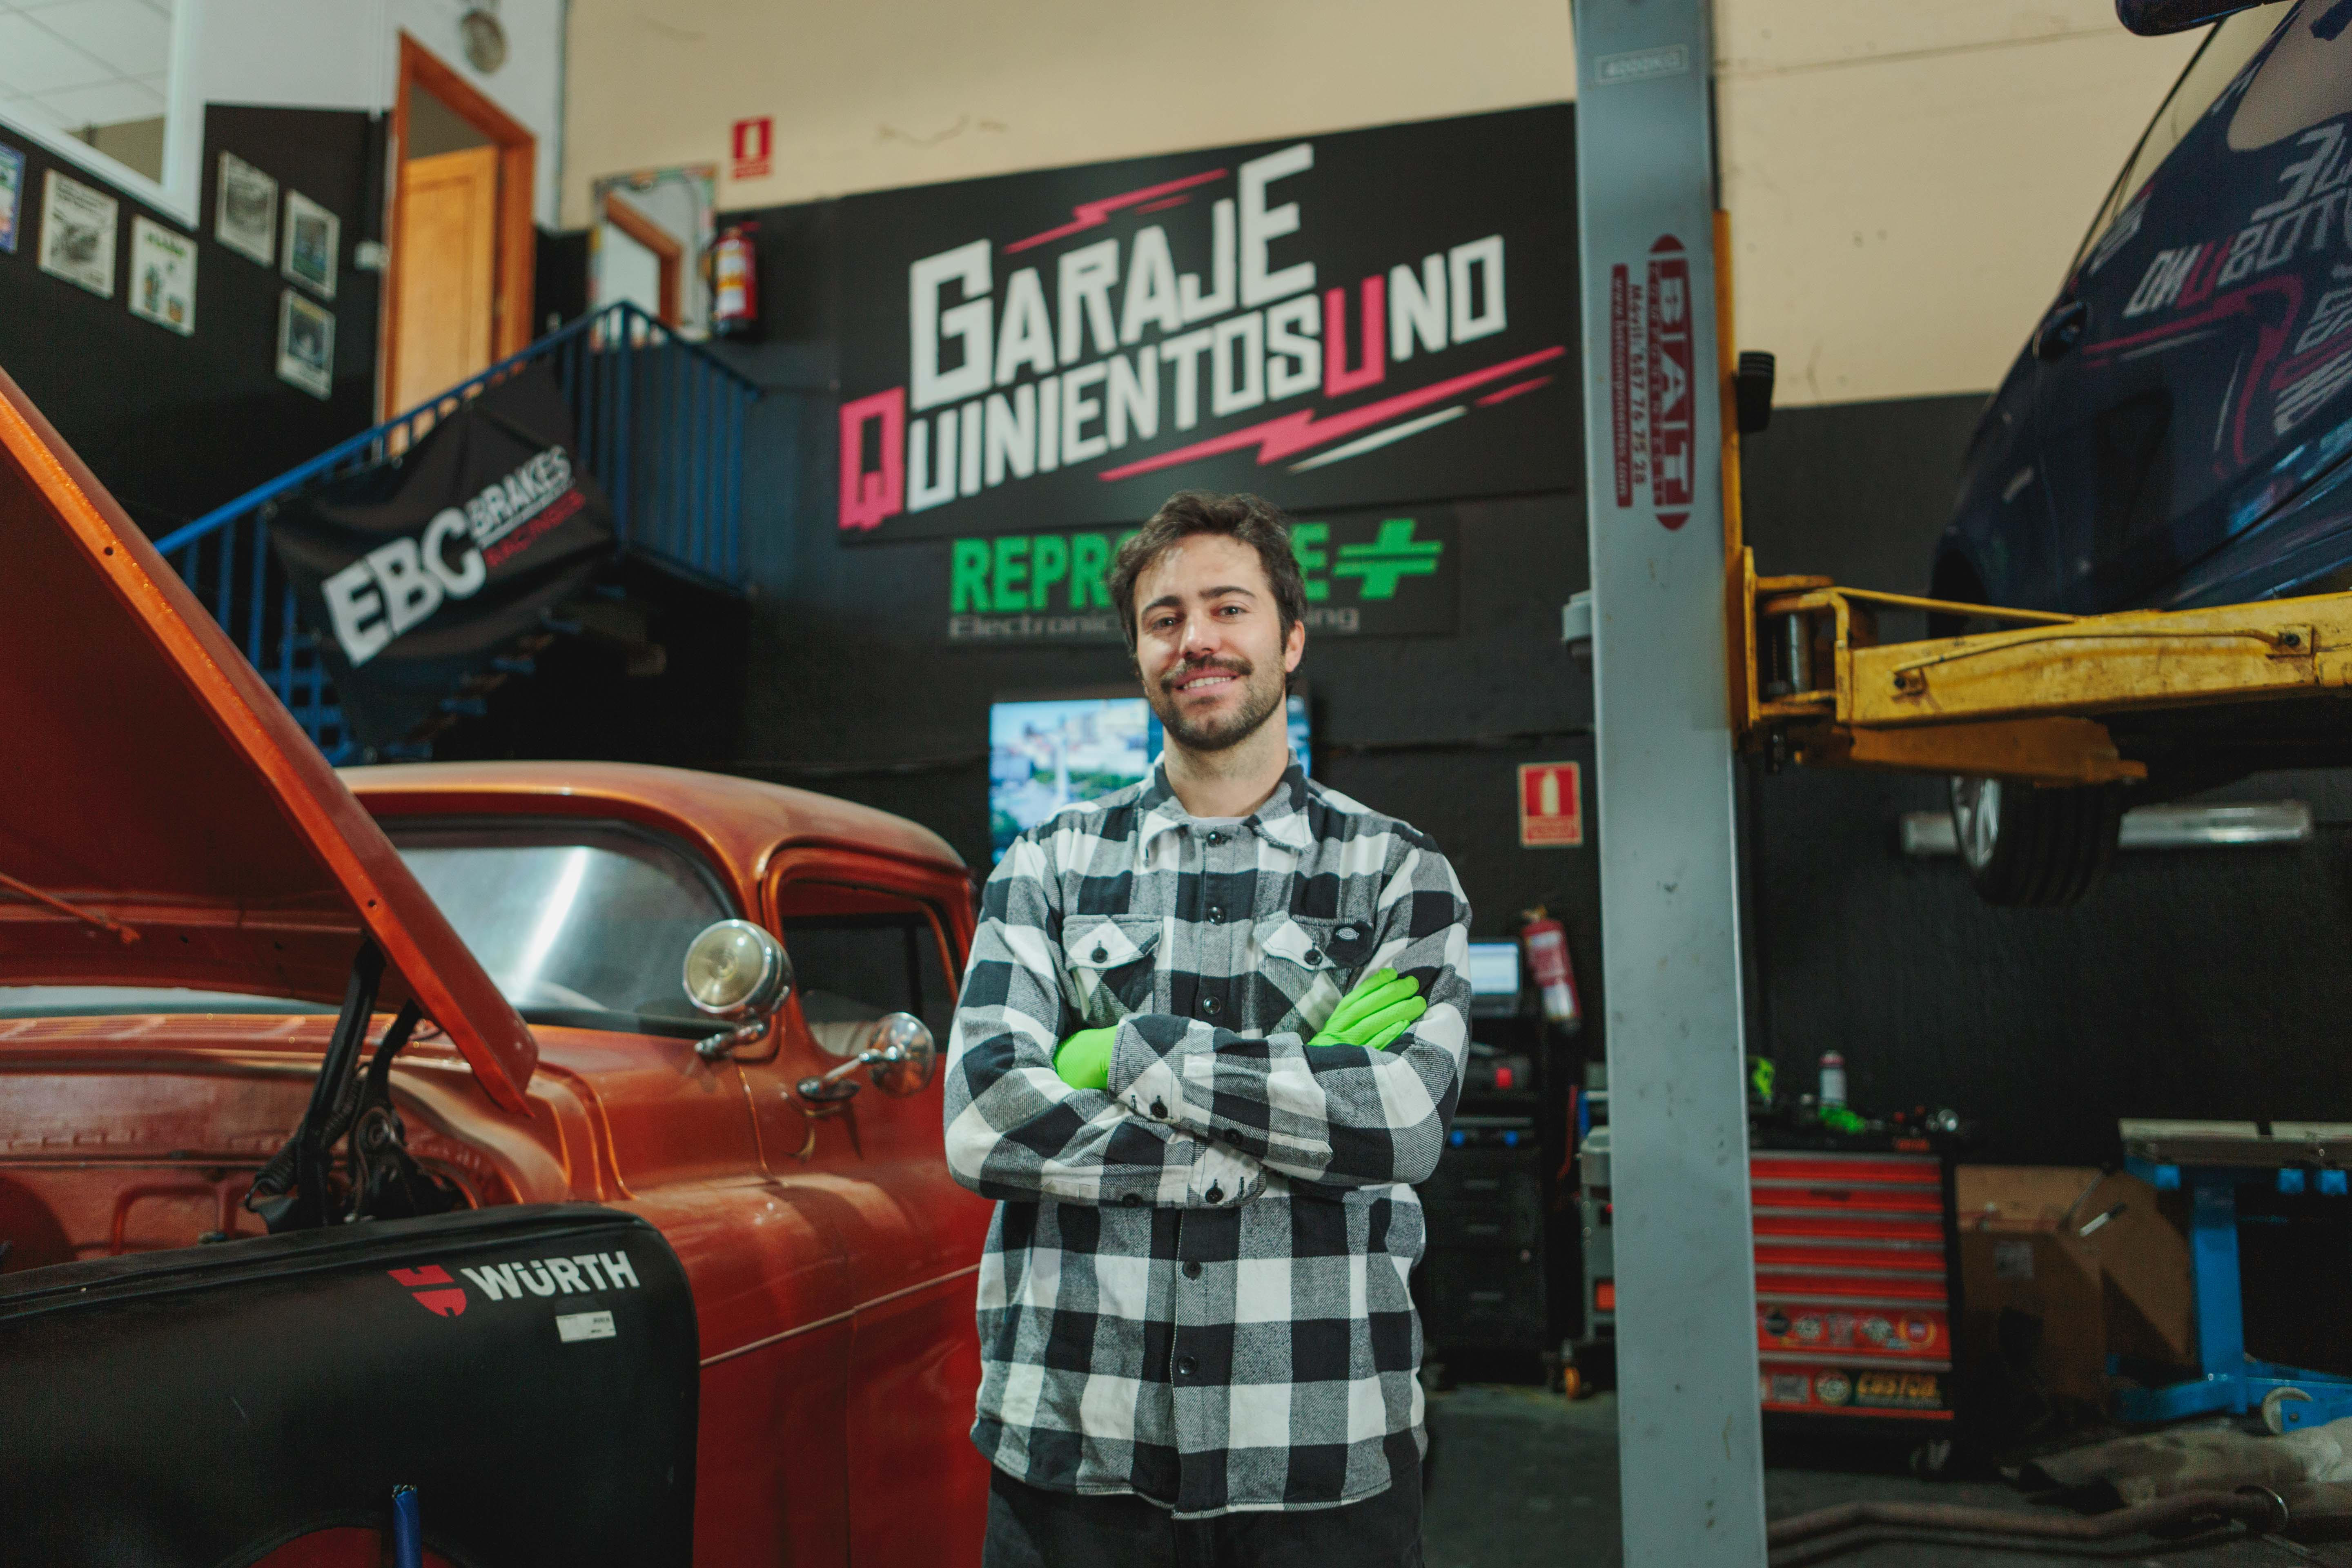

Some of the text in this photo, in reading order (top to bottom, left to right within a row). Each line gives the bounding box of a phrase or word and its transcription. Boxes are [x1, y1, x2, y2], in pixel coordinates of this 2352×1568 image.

[910, 143, 1315, 410] GARAJE
[1659, 276, 1688, 493] BAT
[465, 444, 572, 539] BRAKES
[321, 507, 488, 668] EBC
[460, 1250, 640, 1301] WÜRTH
